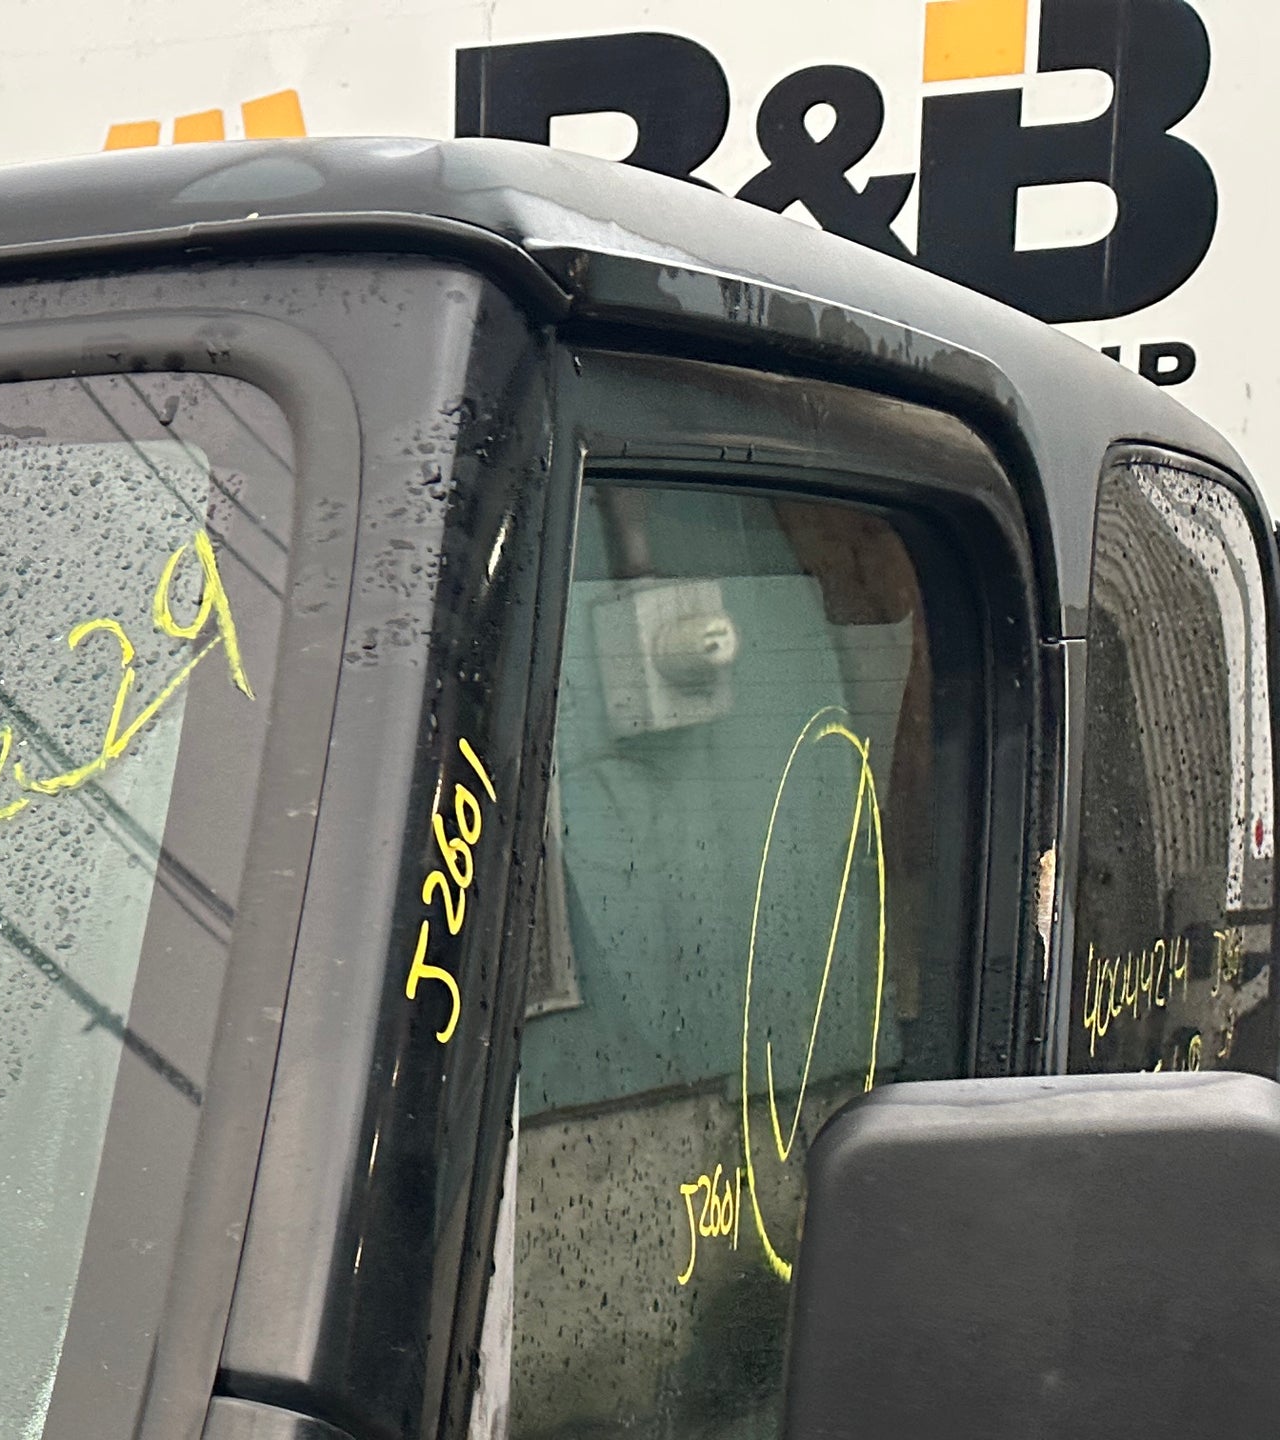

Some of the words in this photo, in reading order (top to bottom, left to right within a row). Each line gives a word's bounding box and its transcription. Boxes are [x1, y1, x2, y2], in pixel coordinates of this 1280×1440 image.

[1101, 341, 1197, 386] P
[405, 738, 496, 1043] J2601
[677, 1164, 741, 1285] J2601
